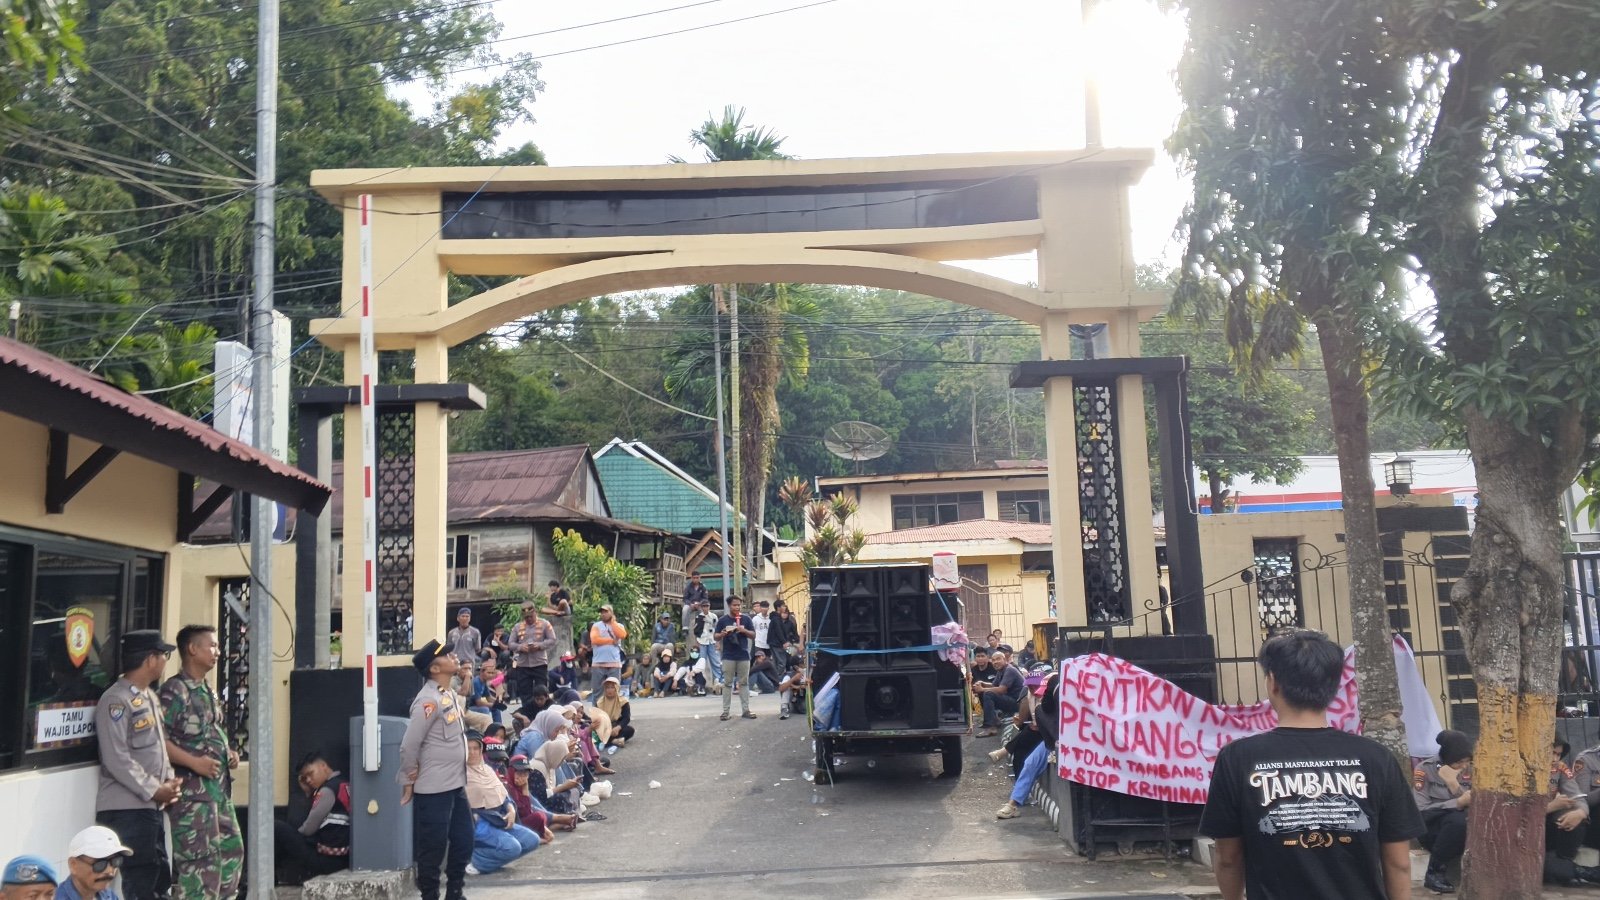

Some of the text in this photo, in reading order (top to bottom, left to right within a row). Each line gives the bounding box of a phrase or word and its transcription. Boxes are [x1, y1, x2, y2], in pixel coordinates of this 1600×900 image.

[1061, 664, 1195, 719] HENTIKAN
[62, 711, 84, 723] TAMU
[44, 726, 70, 738] WAJIB
[1060, 701, 1197, 760] PEJUANG
[1126, 760, 1203, 781] TAMBANG
[1255, 759, 1361, 770] ALIANSI MASYARAKAT TOLAK
[1250, 770, 1368, 807] TAMBANG
